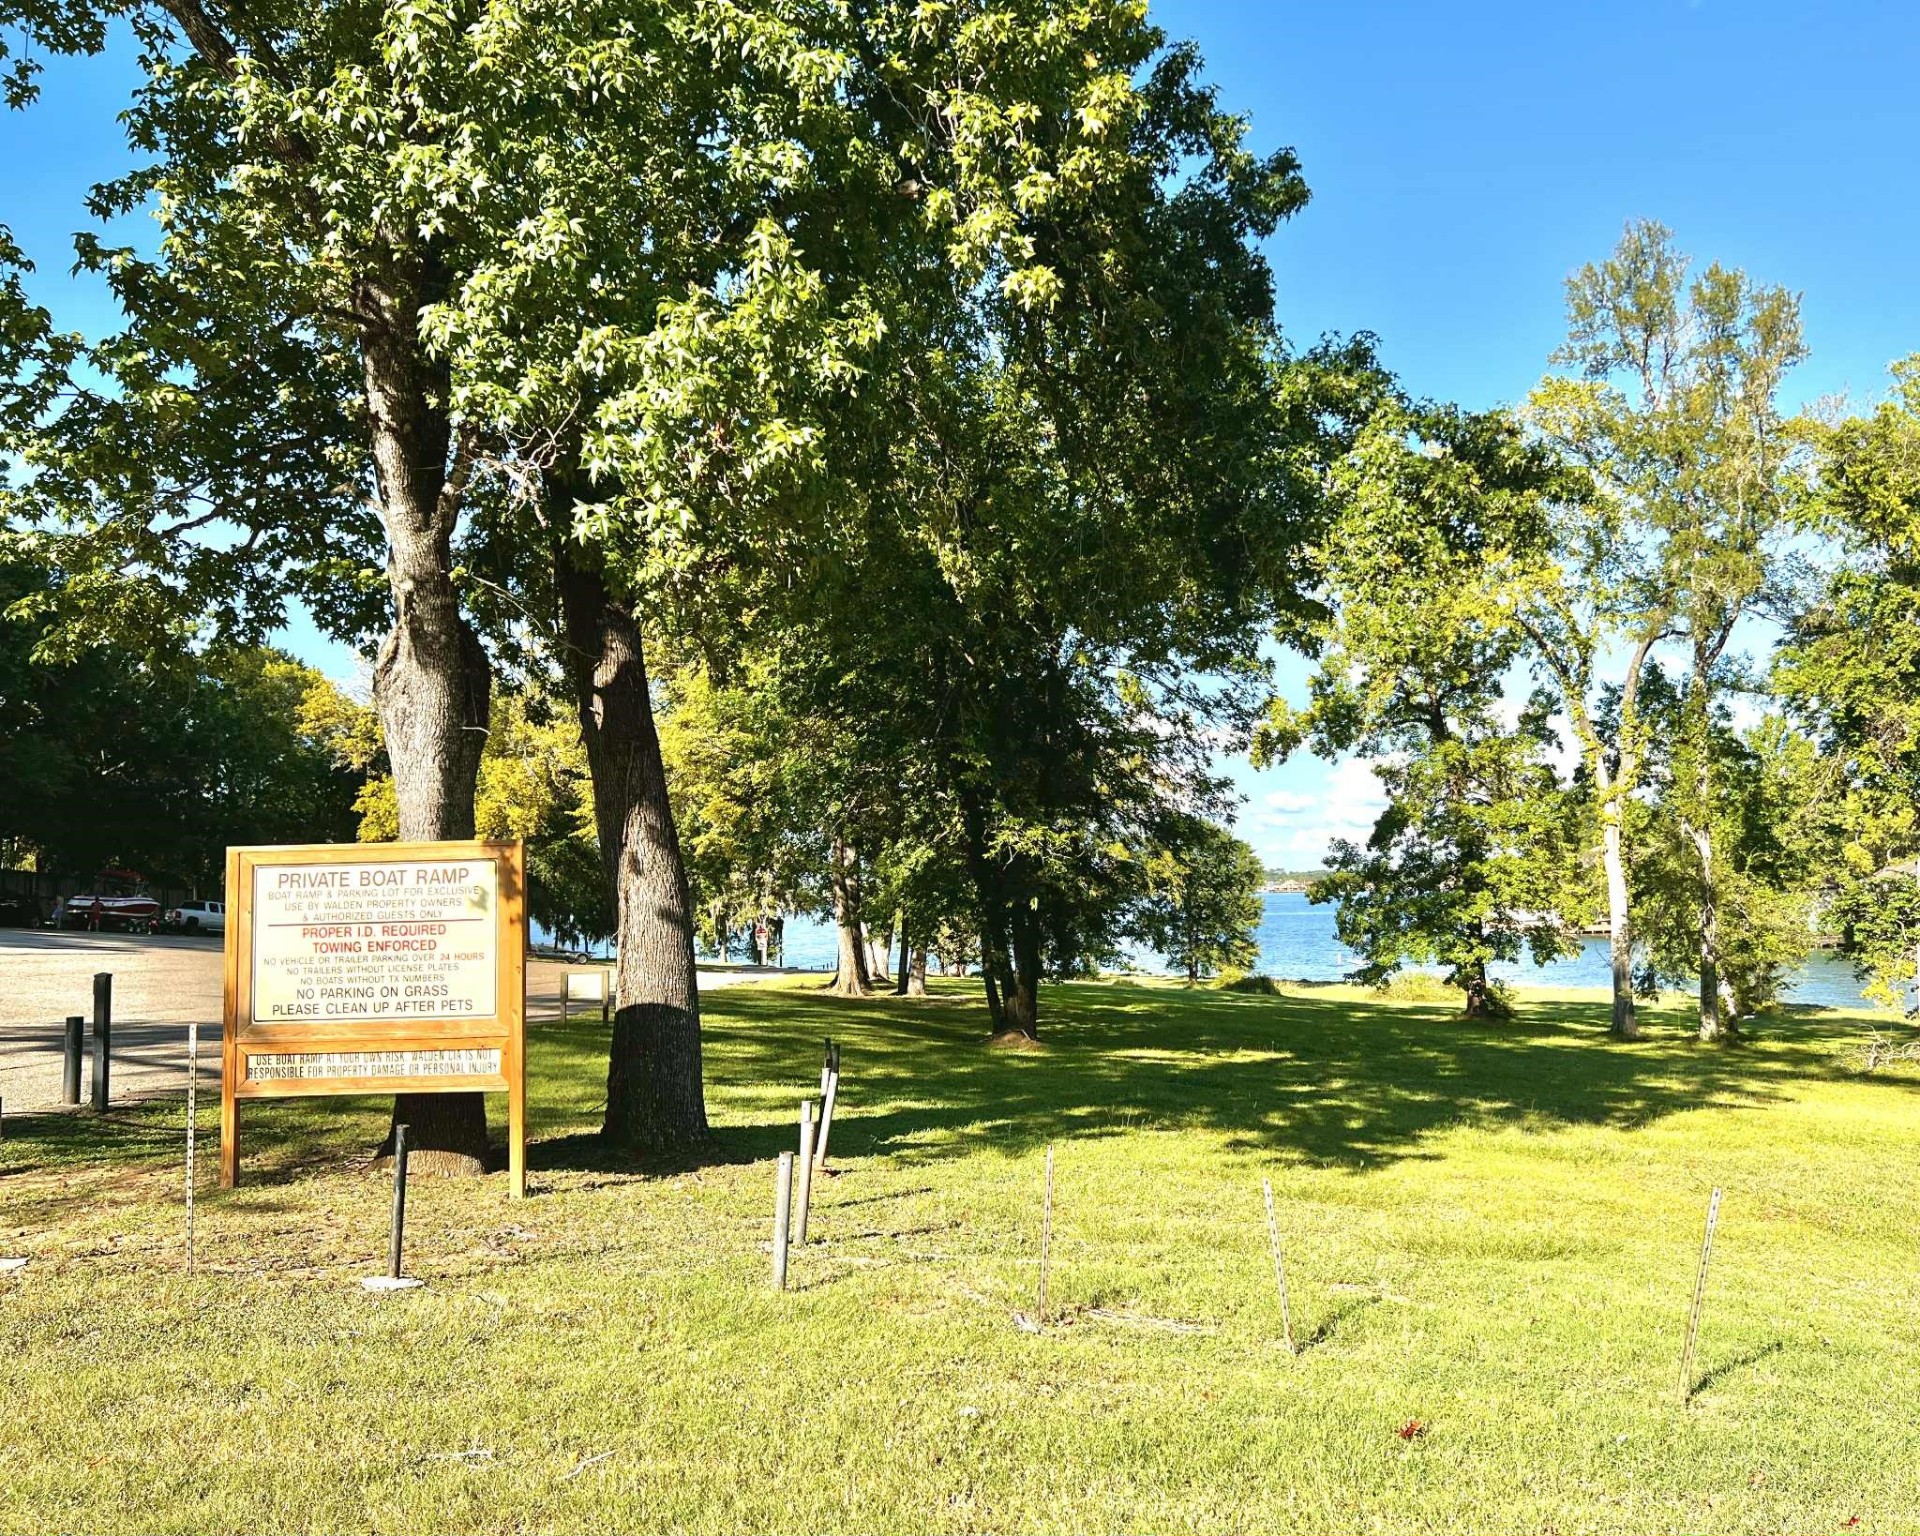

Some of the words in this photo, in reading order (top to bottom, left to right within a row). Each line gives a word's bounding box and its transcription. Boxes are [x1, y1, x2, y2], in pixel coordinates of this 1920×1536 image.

[278, 872, 350, 888] PRIVATE
[360, 870, 407, 886] BOAT
[416, 868, 469, 884] RAMP
[268, 891, 292, 900] BOAT
[296, 890, 322, 899] RAMP
[327, 890, 332, 898] &
[338, 888, 378, 898] PARKING
[382, 888, 400, 896] LOT
[404, 888, 423, 896] FOR
[428, 886, 479, 895] EXCLUSIVE
[285, 902, 303, 911] USE
[308, 902, 319, 910] BY
[324, 901, 362, 910] WALDEN
[367, 899, 416, 908] PROPERTY
[420, 898, 462, 907] OWNERS
[303, 914, 308, 922] &
[314, 912, 372, 921] AUTHORIZED
[378, 910, 415, 919] GUESTS
[420, 910, 443, 918] ONLY
[303, 926, 352, 938] PROPER
[358, 926, 376, 937] I.D.
[382, 924, 446, 936] REQUIRED
[313, 941, 361, 953] TOWING
[368, 940, 437, 952] ENFORCED
[280, 957, 314, 965] VEHICLE
[318, 956, 330, 964] OR
[372, 954, 408, 962] PARKING
[412, 953, 434, 961] OVER
[454, 952, 484, 960] HOURS
[287, 967, 298, 975] NO
[303, 966, 342, 974] TRAILERS
[346, 965, 384, 974] WITHOUT
[388, 964, 423, 972] LICENSE
[428, 963, 460, 971] PLATES
[301, 977, 312, 985] NO
[403, 974, 445, 982] NUMBERS
[297, 988, 314, 999] NO
[321, 987, 374, 998] PARKING
[380, 986, 398, 997] ON
[405, 985, 448, 996] GRASS
[272, 1004, 320, 1016] PLEASE
[326, 1002, 367, 1014] CLEAN
[373, 1002, 389, 1013] UP
[395, 1000, 434, 1012] AFTER
[441, 999, 473, 1011] PETS
[249, 1066, 304, 1078] RESPONSIBLE
[308, 1066, 322, 1077] FOR
[327, 1065, 368, 1076] PROPERTY
[372, 1064, 405, 1075] DAMAGE
[409, 1064, 418, 1074] OR
[423, 1063, 465, 1074] PERSONAL
